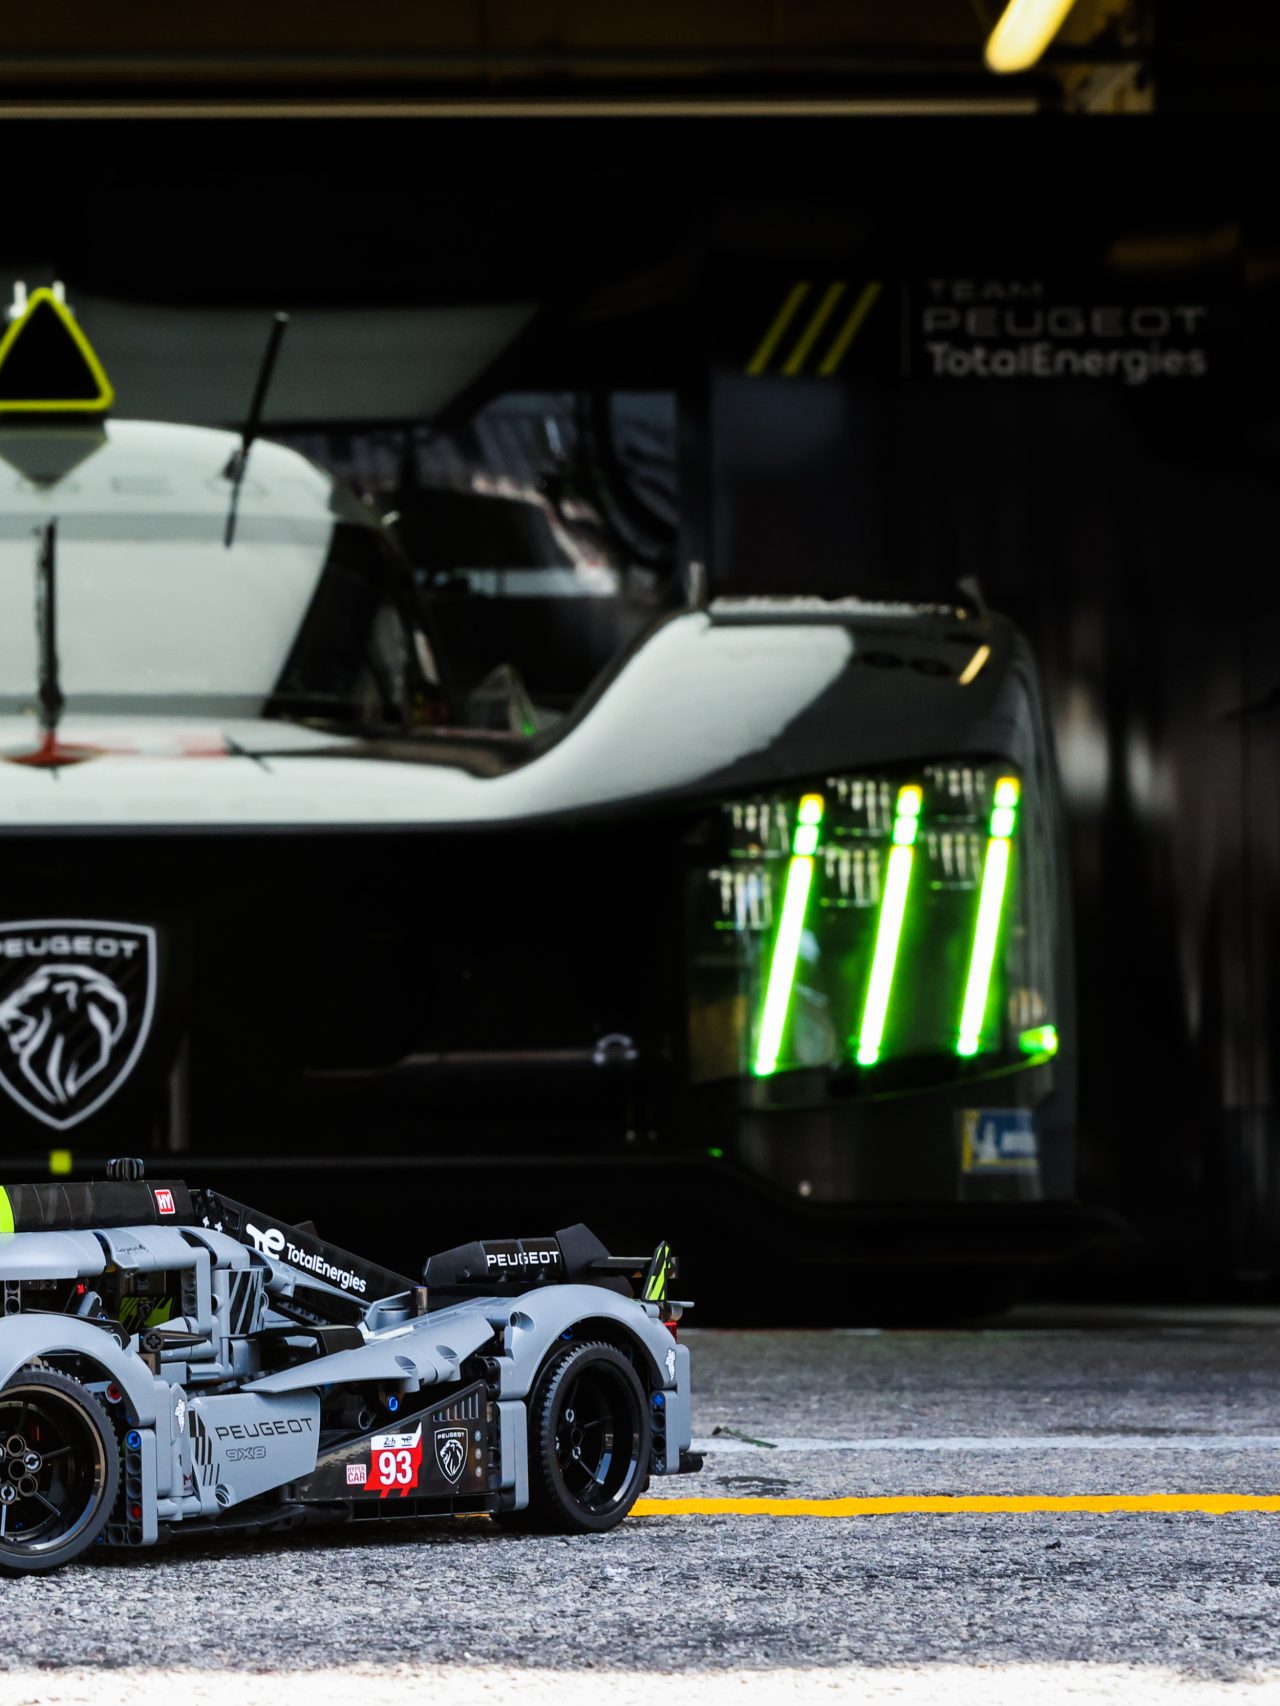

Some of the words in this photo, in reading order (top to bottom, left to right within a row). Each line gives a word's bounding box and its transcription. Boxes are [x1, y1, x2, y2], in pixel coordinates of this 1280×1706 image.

[921, 306, 1209, 338] PEUGEOT
[924, 340, 1209, 385] TotalEnergies
[157, 1194, 173, 1210] HY
[286, 1242, 367, 1293] TotalEnergies
[486, 1250, 559, 1268] PEUGEOT
[214, 1417, 312, 1441] PEUGEOT
[437, 1432, 465, 1440] PEUGEOT
[225, 1446, 267, 1463] 9X8
[347, 1465, 365, 1473] HYPER
[347, 1472, 366, 1482] CAR
[378, 1450, 413, 1486] 93
